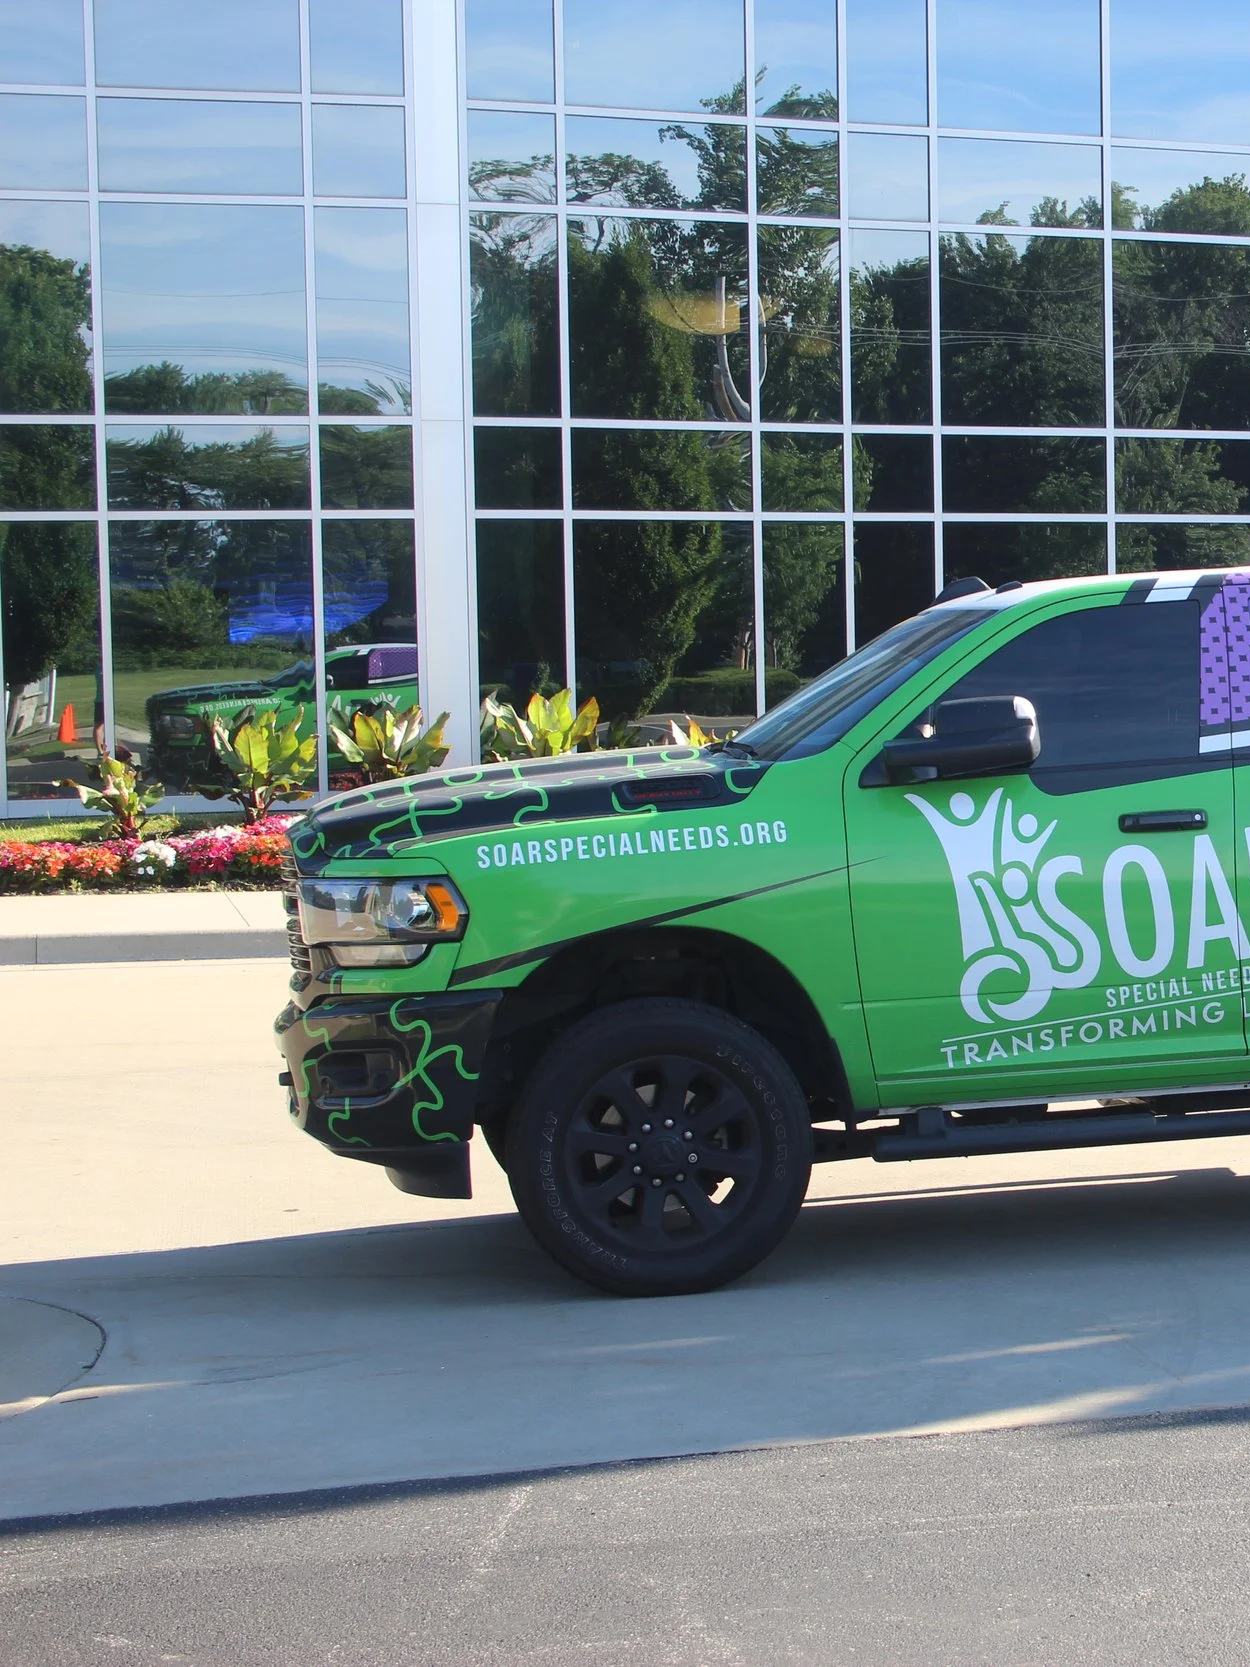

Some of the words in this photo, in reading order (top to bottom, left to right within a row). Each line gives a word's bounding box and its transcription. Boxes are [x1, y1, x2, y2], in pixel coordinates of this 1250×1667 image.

[476, 820, 788, 869] SOARSPECIALNEEDS.ORG
[1106, 977, 1193, 1007] SPECIAL
[940, 1001, 1226, 1069] TRANSFORMING
[542, 1110, 561, 1143] AT
